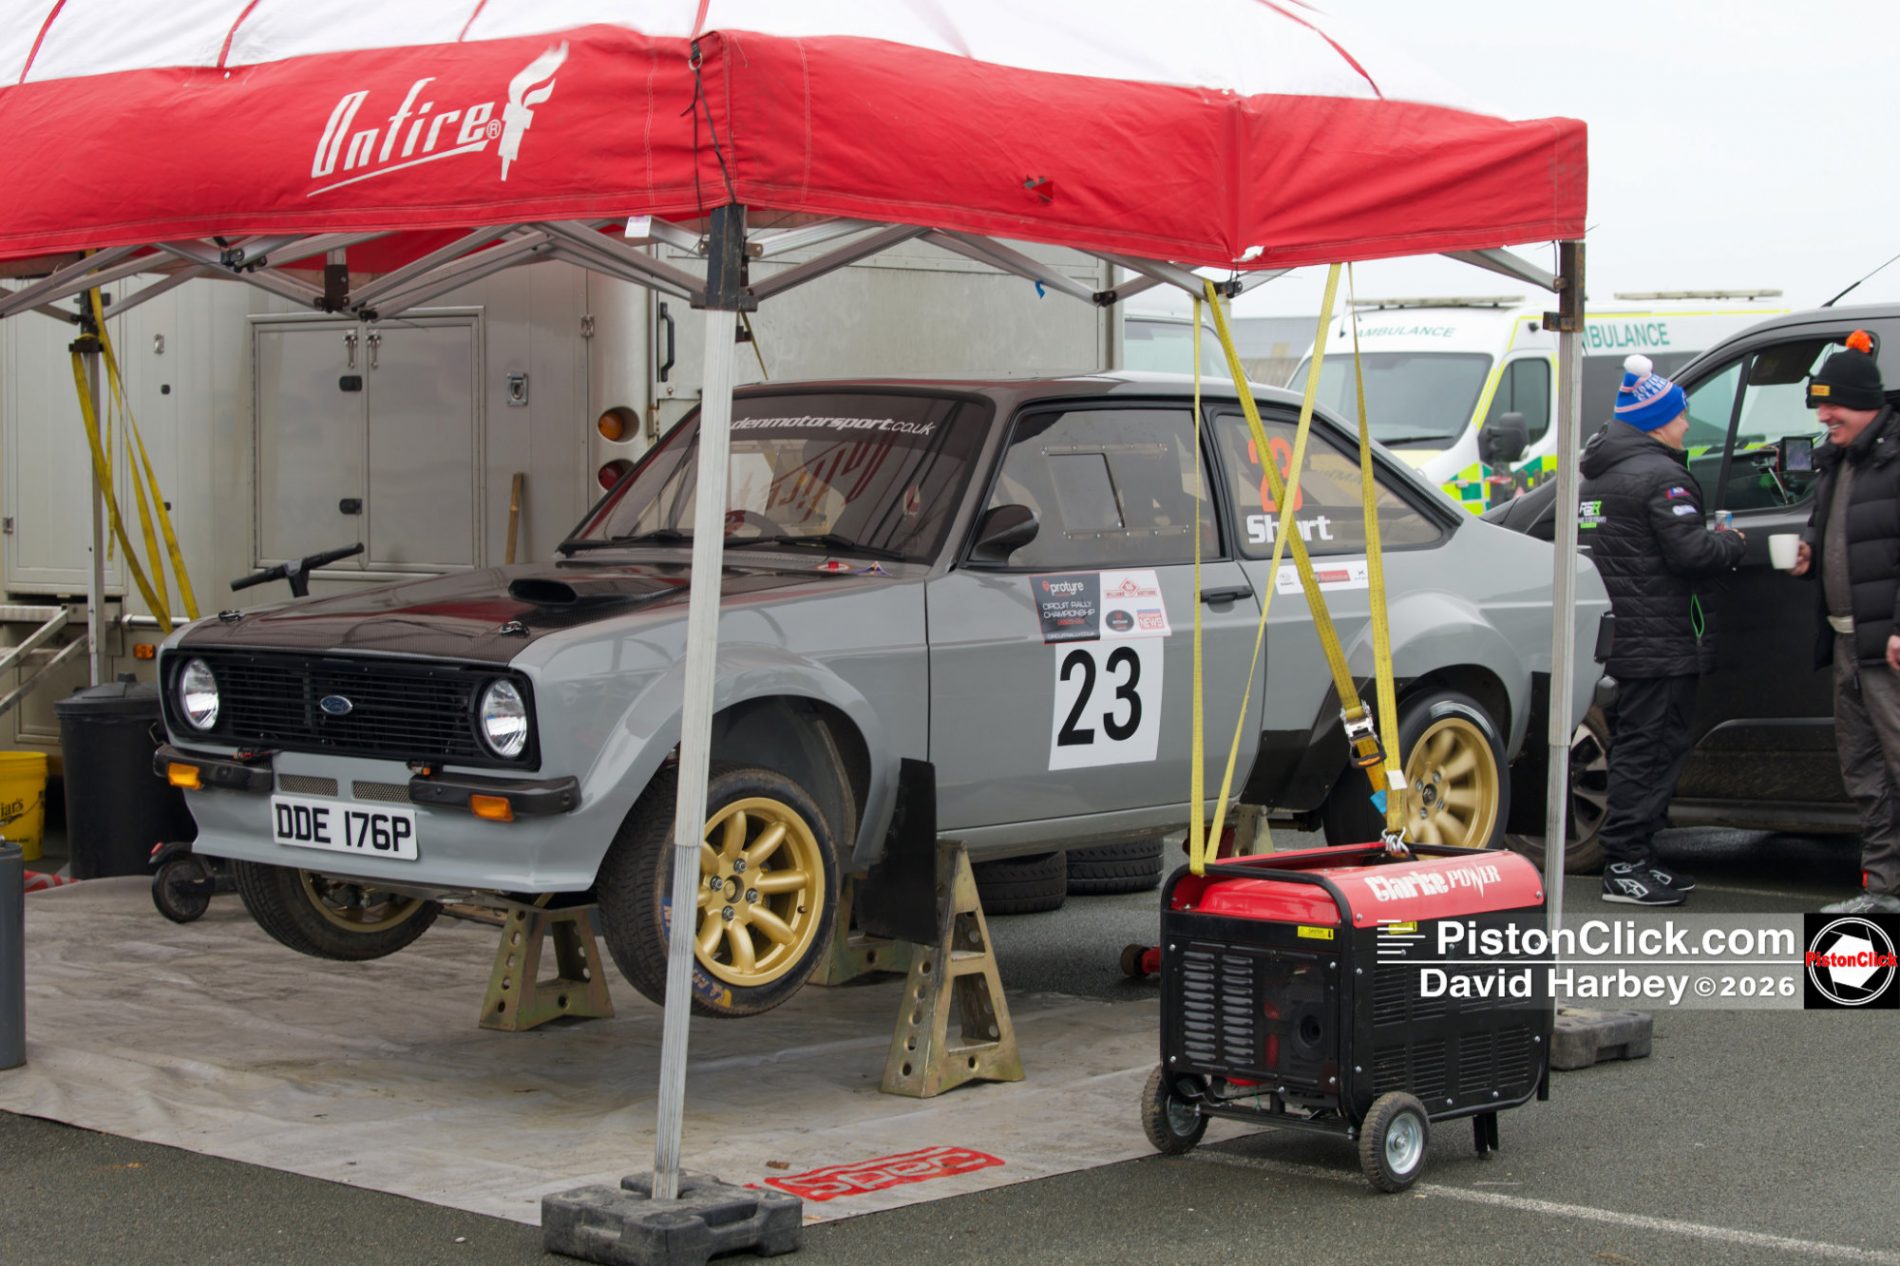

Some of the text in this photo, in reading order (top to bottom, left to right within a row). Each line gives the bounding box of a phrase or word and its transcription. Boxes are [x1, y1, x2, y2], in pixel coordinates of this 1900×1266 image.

[1357, 326, 1456, 338] AMBULANCE
[1247, 515, 1333, 544] Shrt
[1050, 581, 1085, 596] protyre
[1057, 646, 1142, 747] 23
[275, 803, 411, 852] DDE 176P
[1364, 863, 1501, 902] Clarke POWER
